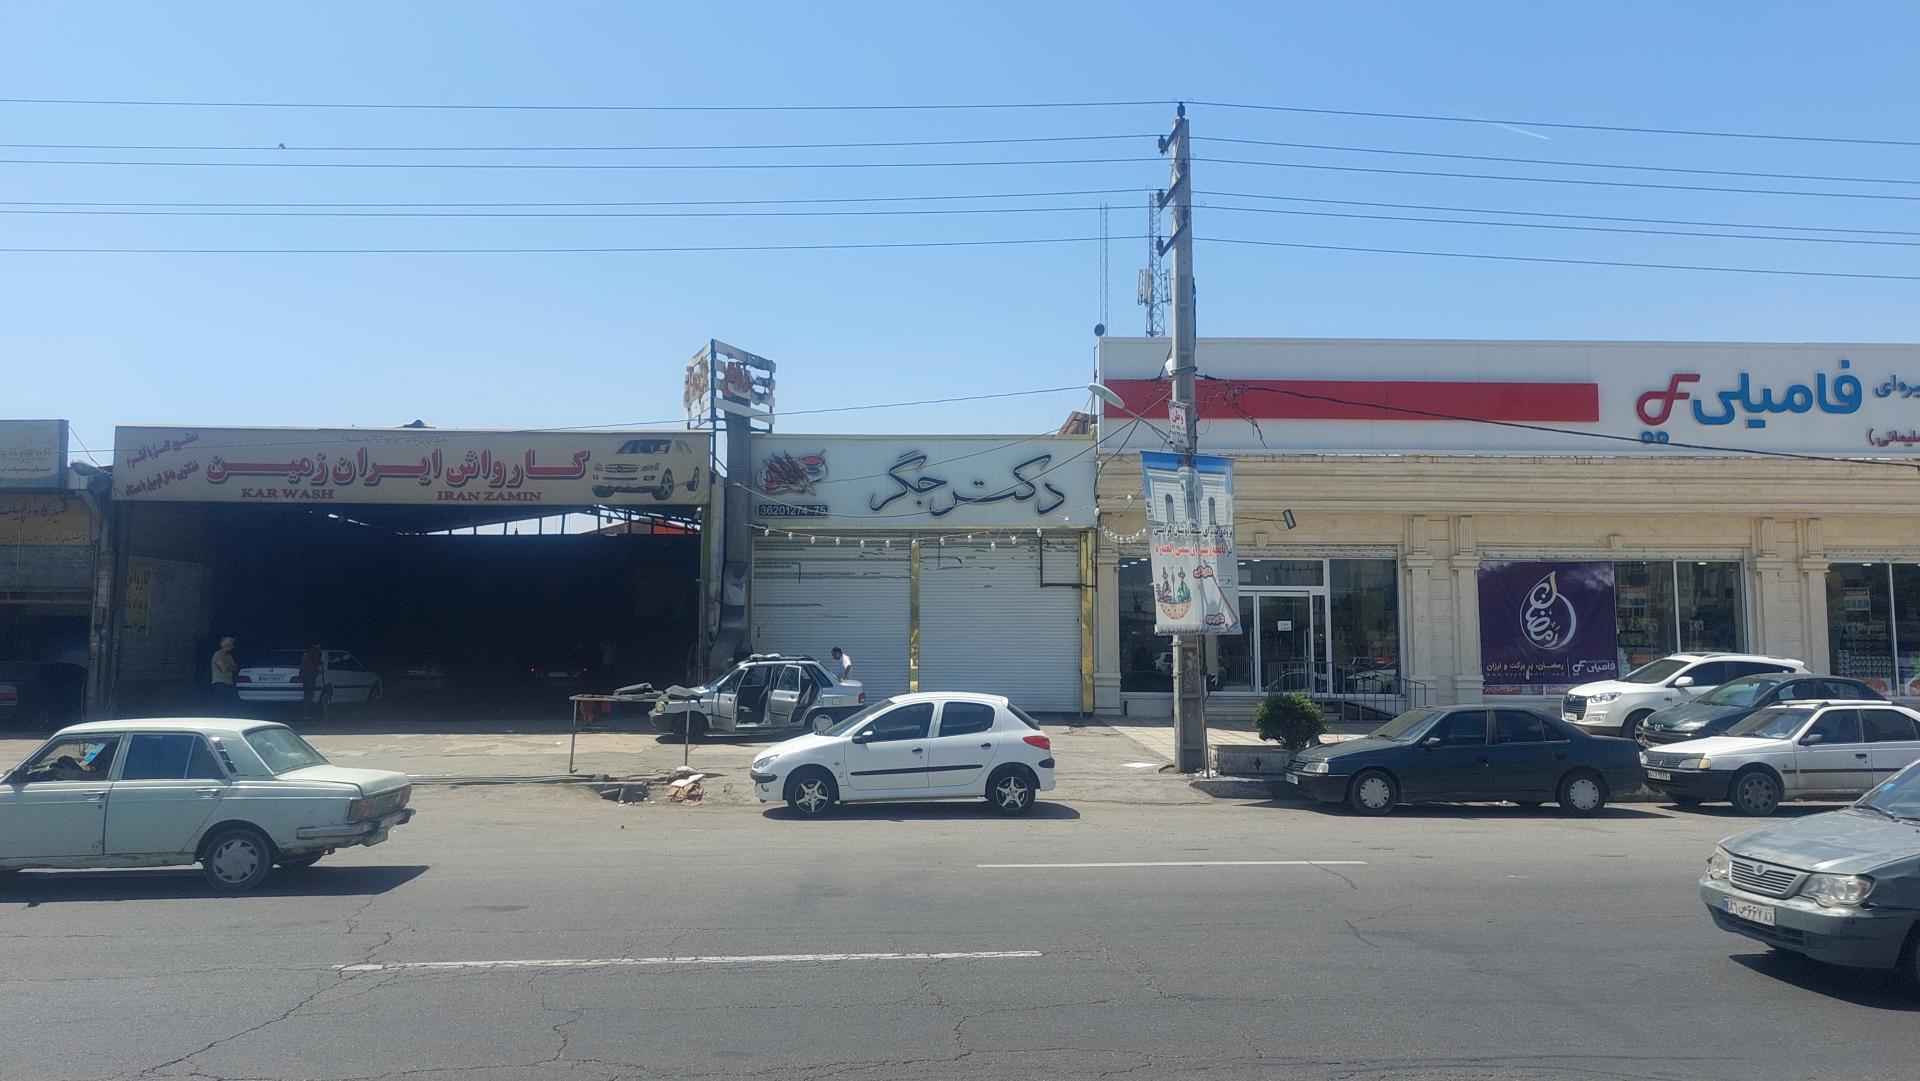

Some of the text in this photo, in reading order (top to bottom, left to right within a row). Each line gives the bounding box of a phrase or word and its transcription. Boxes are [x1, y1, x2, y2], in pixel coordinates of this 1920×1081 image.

[1692, 359, 1863, 428] فامیلی
[207, 447, 591, 488] کارواش ایران زمین
[241, 488, 335, 499] KAR WASH
[437, 491, 541, 501] IRAN ZAMIN
[869, 450, 1065, 516] دکتر جگر
[760, 505, 827, 516] 36201274-75
